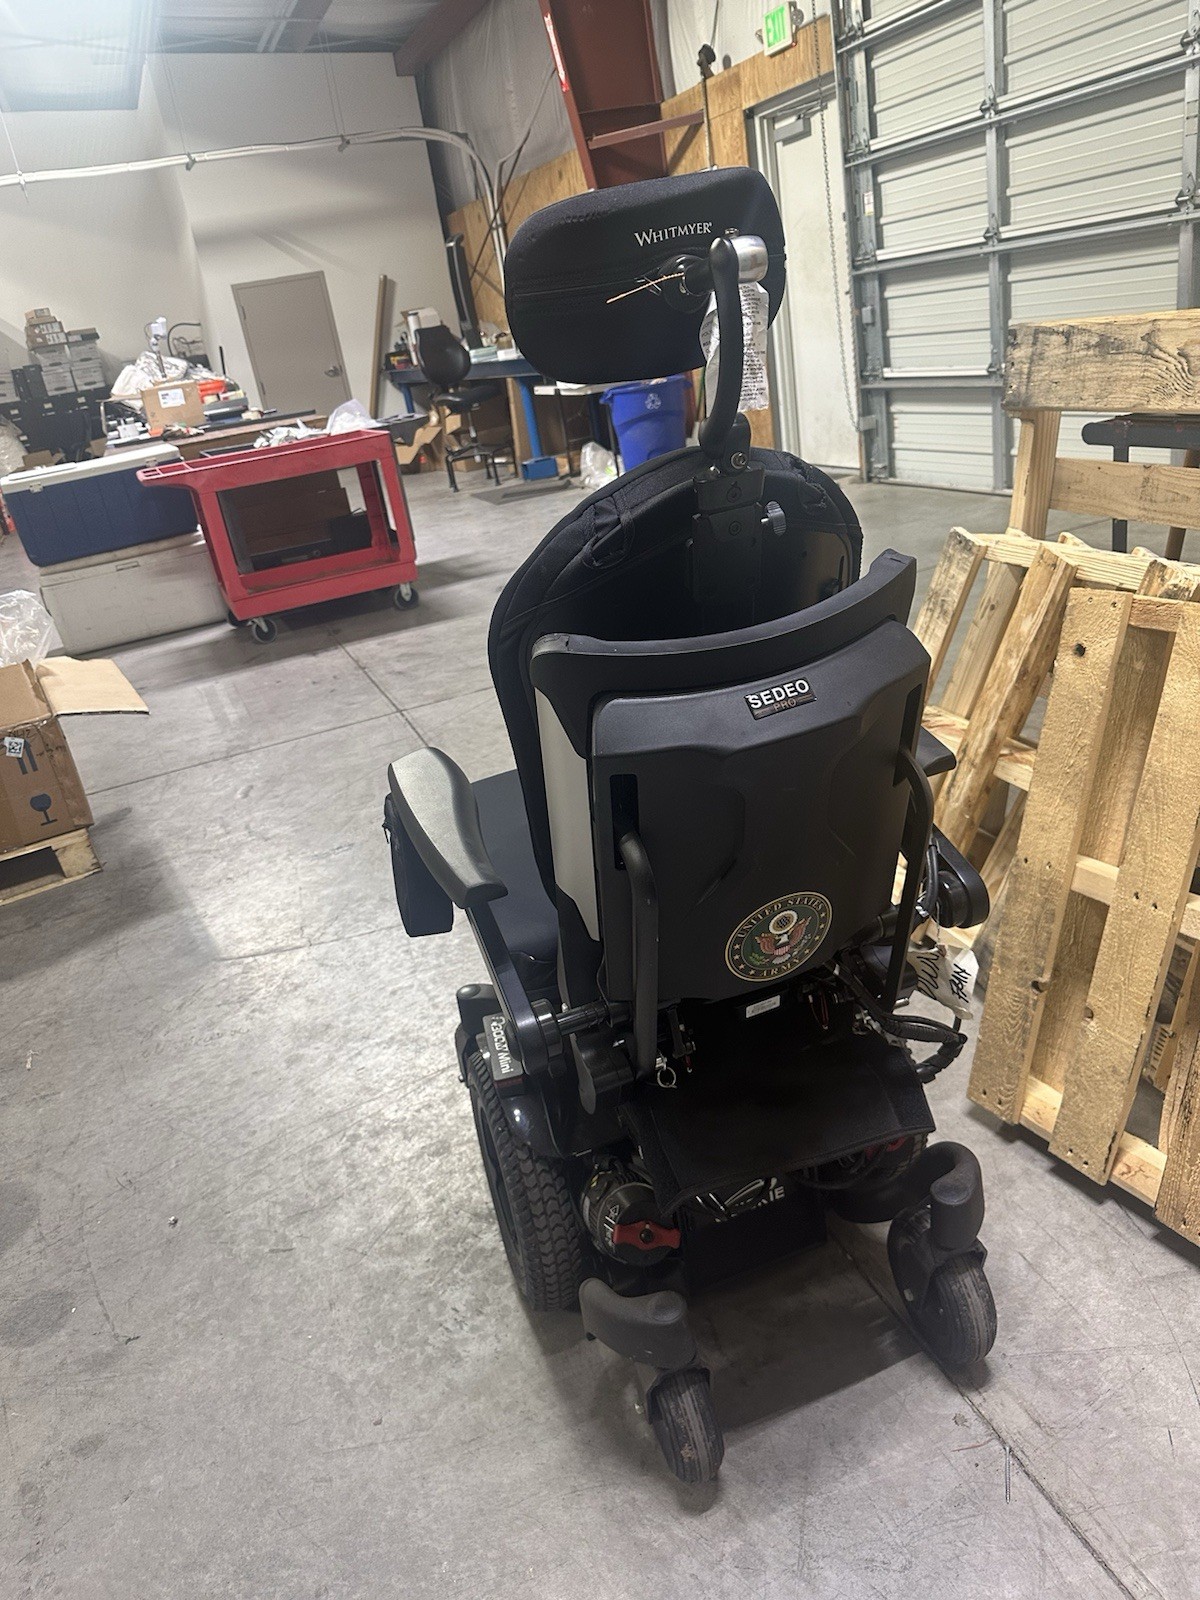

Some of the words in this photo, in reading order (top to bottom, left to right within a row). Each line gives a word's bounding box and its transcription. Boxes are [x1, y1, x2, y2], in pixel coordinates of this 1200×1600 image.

[765, 6, 785, 48] EXIT
[746, 680, 809, 709] SEDEO
[773, 698, 796, 712] PRO
[737, 903, 782, 938] UNITED
[787, 897, 824, 911] STATES
[762, 958, 800, 977] ARMY
[498, 1052, 514, 1074] Mini
